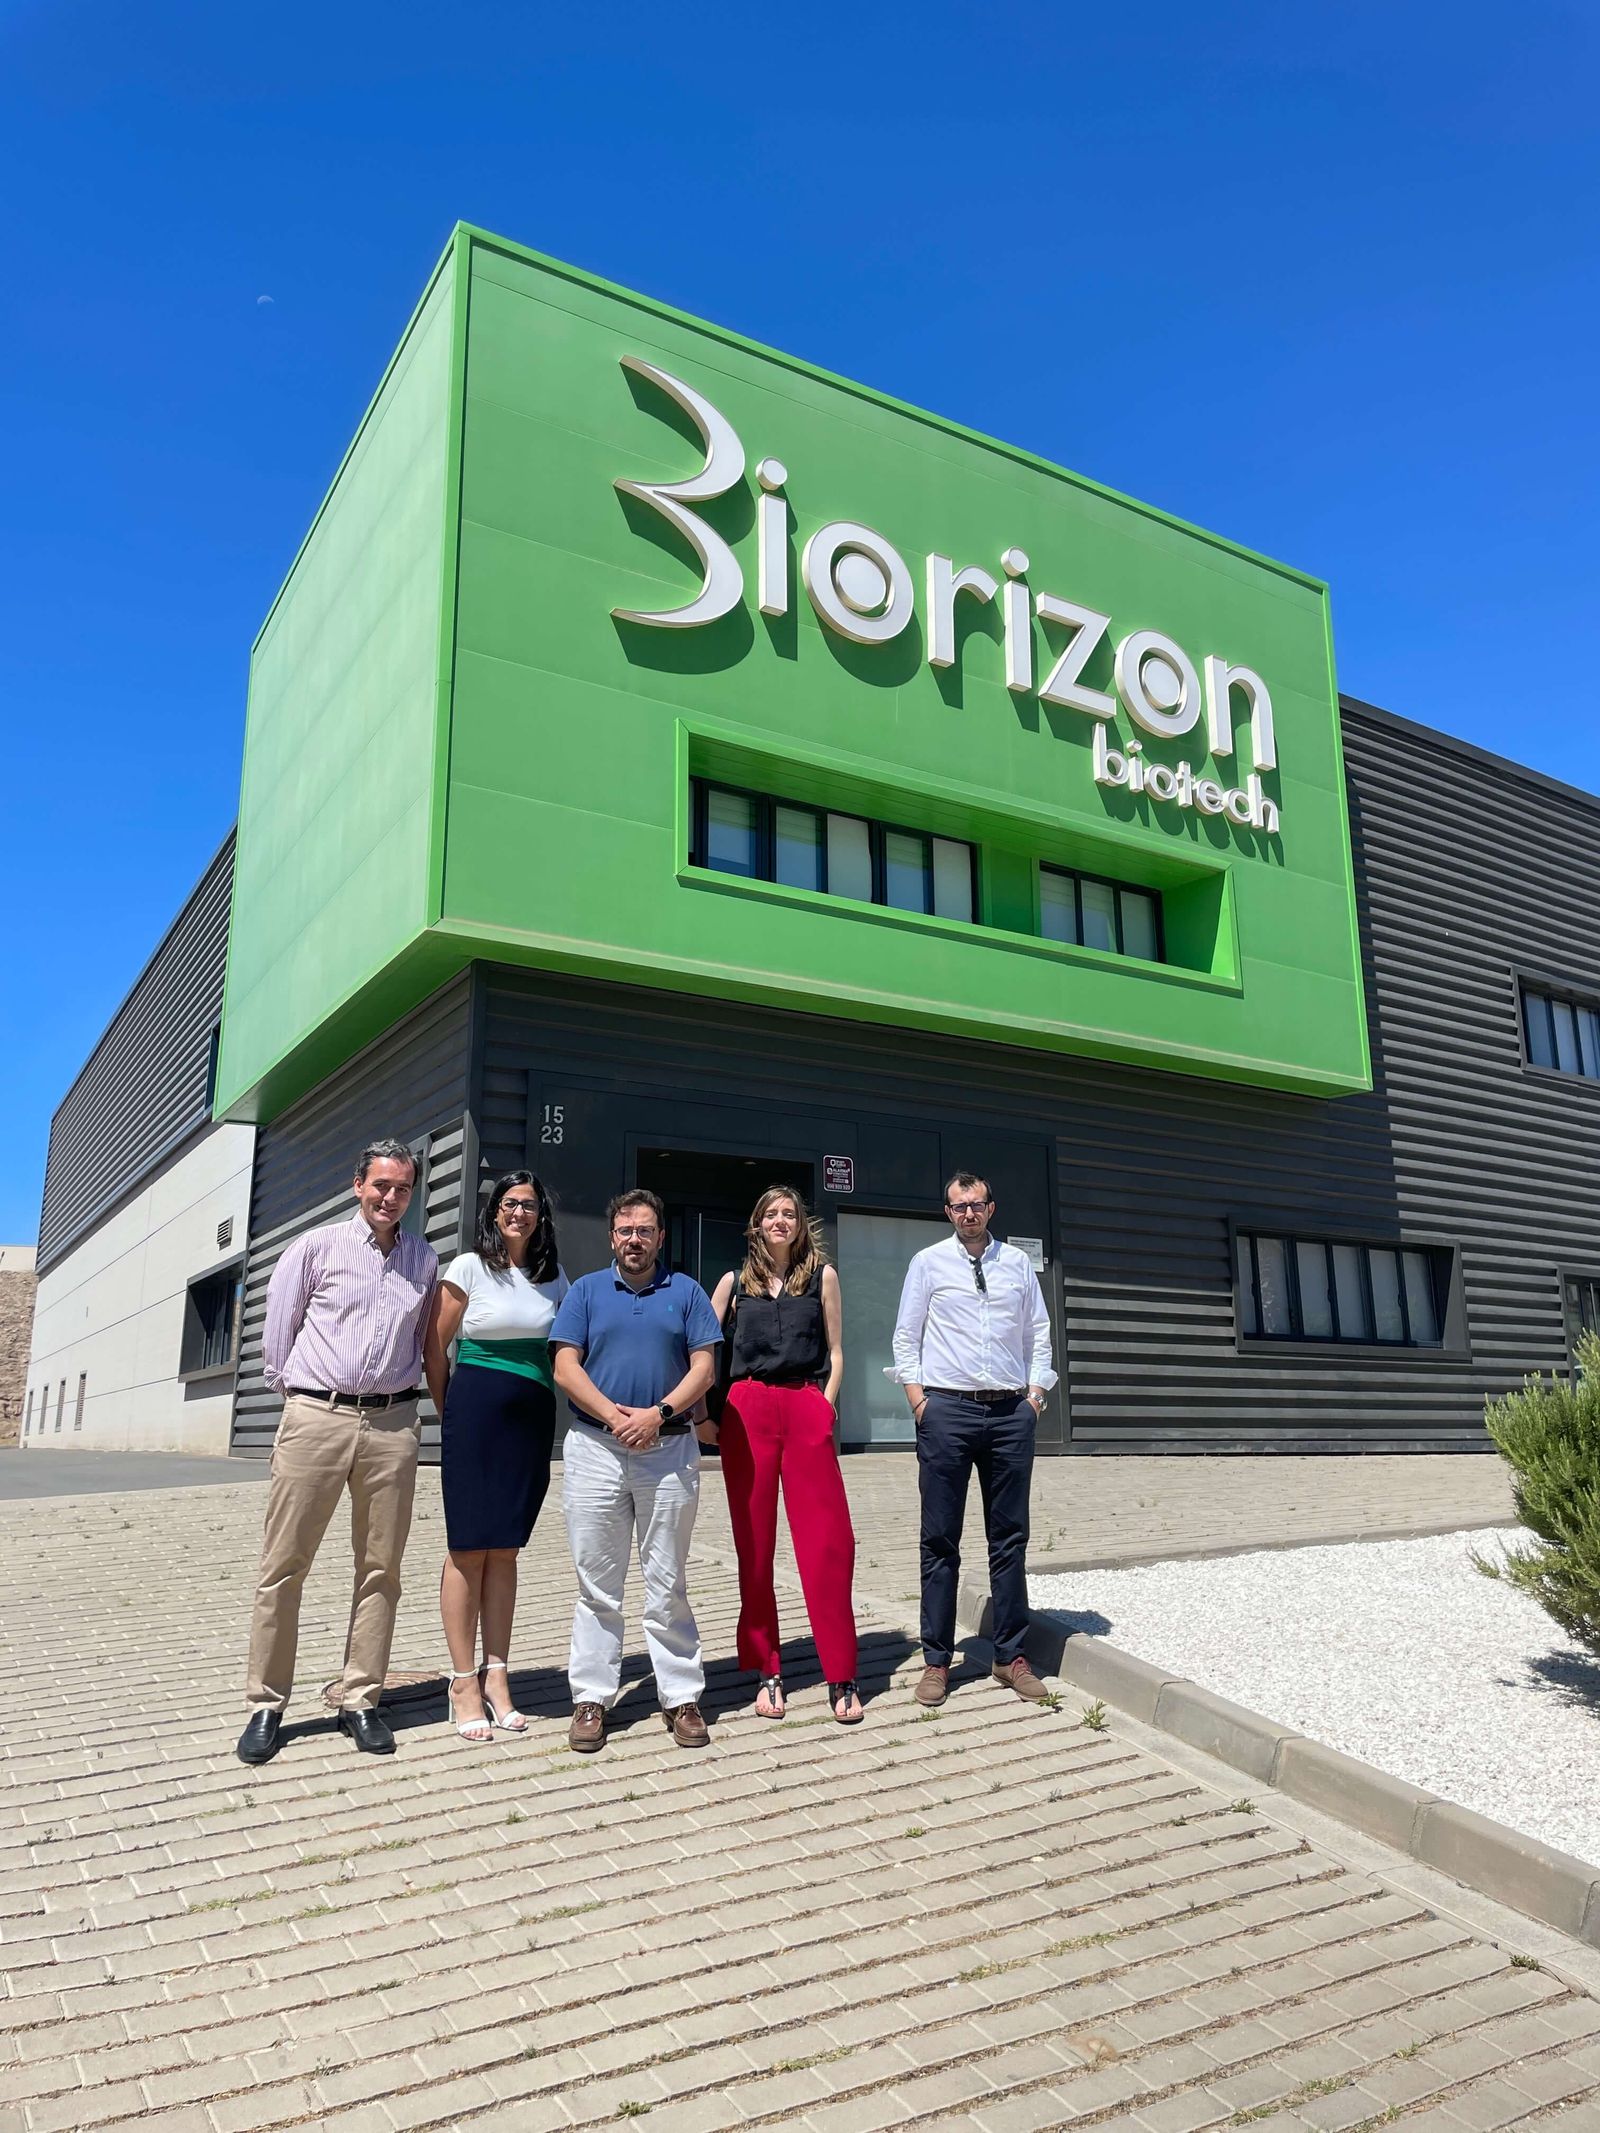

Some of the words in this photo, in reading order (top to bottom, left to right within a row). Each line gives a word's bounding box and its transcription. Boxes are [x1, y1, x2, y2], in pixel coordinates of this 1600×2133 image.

[610, 354, 1277, 772] Biorizon
[1091, 722, 1280, 834] biotech
[541, 1125, 564, 1145] 23
[544, 1104, 564, 1124] 15
